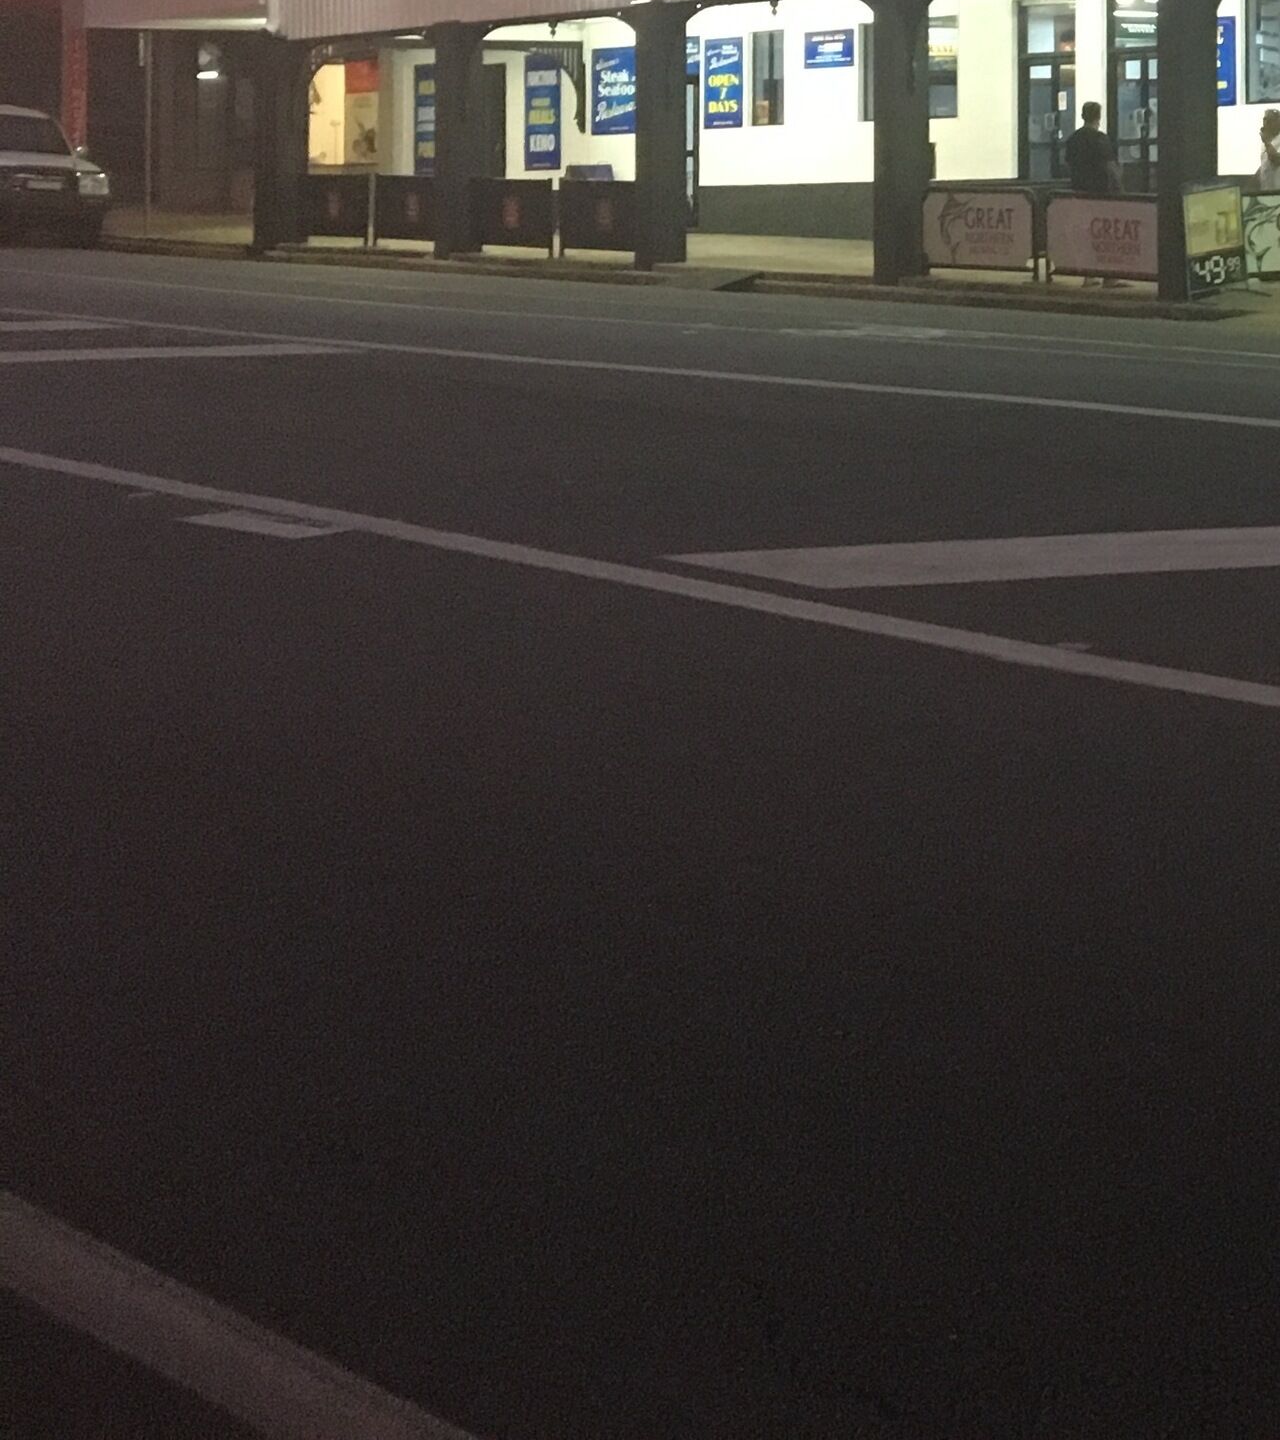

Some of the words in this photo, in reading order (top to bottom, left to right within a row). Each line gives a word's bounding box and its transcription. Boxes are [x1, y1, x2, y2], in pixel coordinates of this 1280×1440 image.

[708, 73, 739, 87] OPEN
[597, 83, 636, 98] Seafoo
[708, 100, 738, 114] DAYS
[964, 208, 1014, 230] GREAT
[1090, 217, 1142, 241] GREAT
